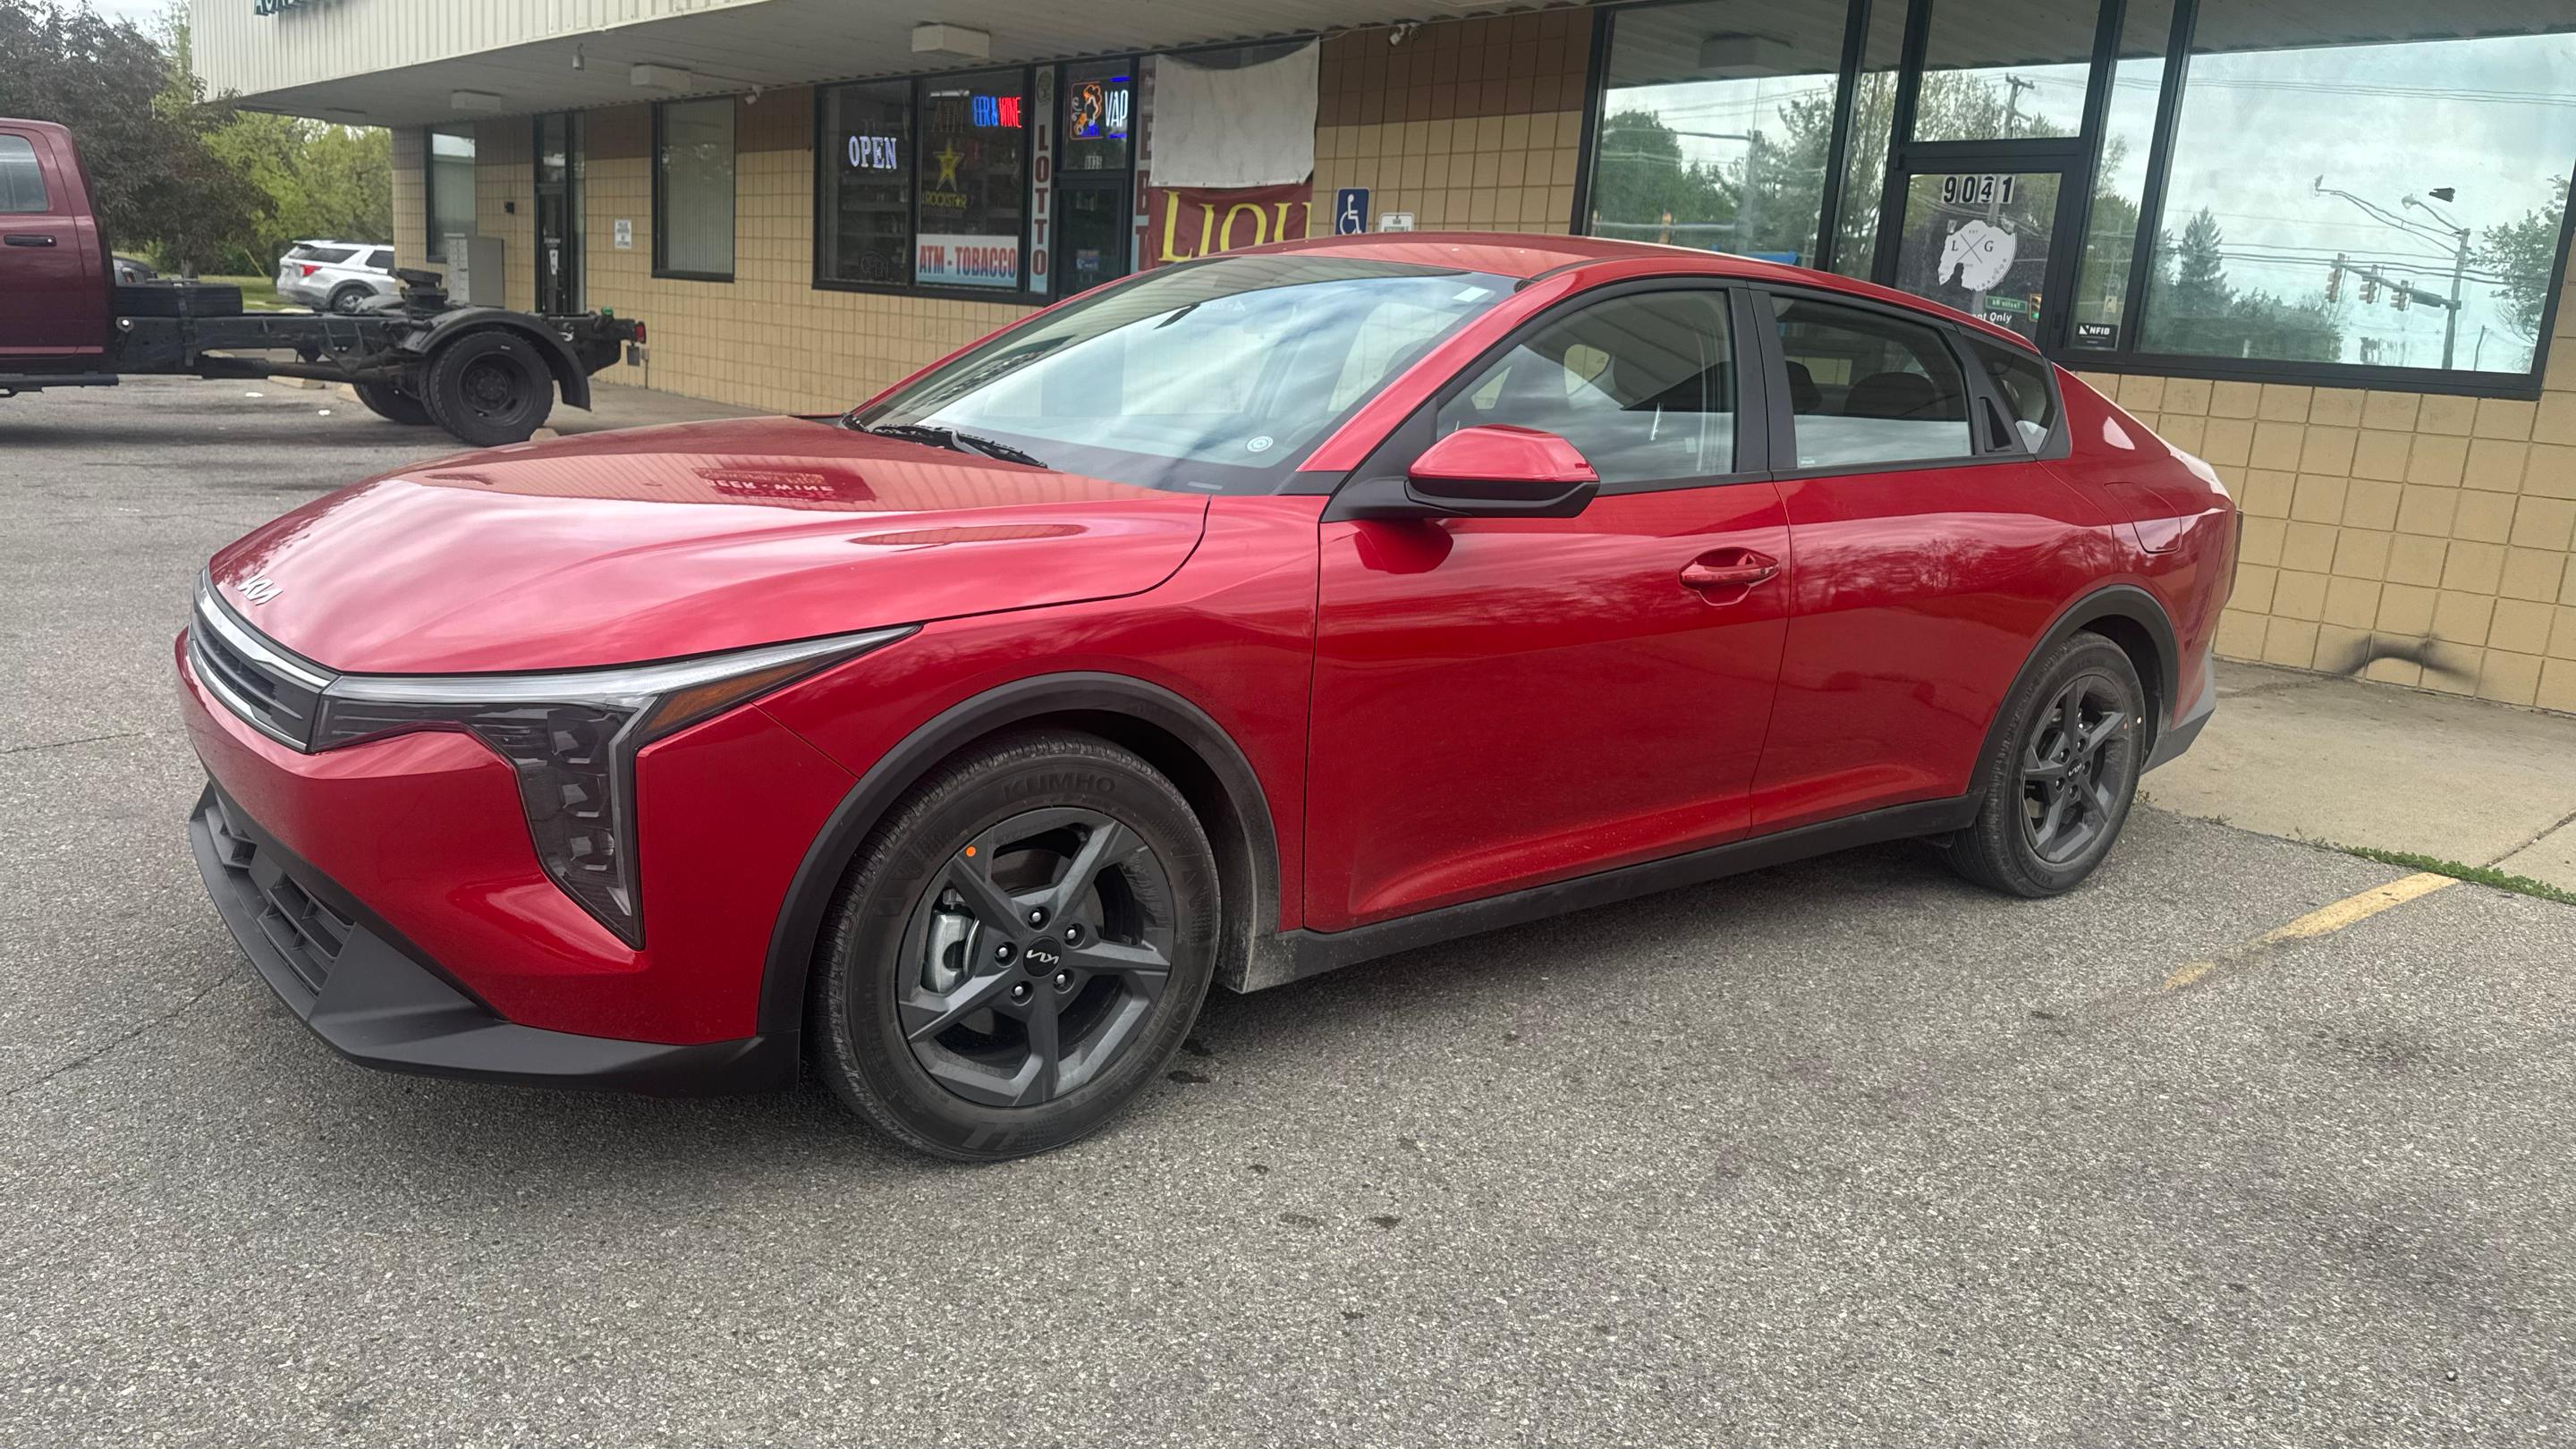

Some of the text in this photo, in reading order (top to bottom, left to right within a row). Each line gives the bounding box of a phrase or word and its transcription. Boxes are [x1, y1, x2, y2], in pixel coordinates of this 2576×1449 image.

[998, 97, 1022, 128] WINE
[848, 135, 897, 170] OPEN
[1032, 124, 1050, 276] LOTTO
[1943, 176, 2012, 203] 9041
[1952, 240, 1994, 252] L G
[919, 245, 945, 275] ATM
[955, 246, 1017, 278] TOBACCO
[1989, 312, 2012, 323] Only
[1003, 772, 1115, 801] KUMHO
